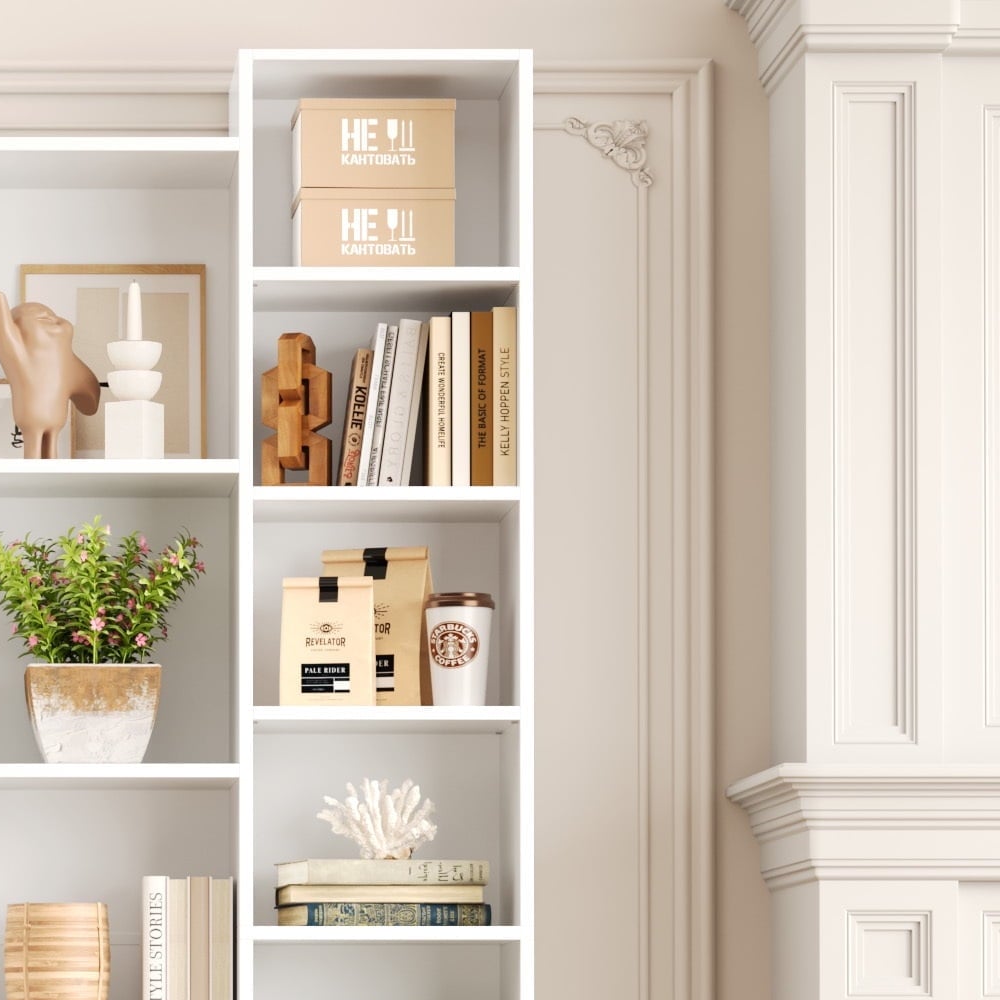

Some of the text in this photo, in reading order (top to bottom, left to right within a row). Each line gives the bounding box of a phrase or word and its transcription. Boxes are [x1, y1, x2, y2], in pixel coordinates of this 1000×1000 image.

[341, 118, 378, 151] НЕ
[341, 154, 416, 166] КАНТОВАТЬ
[341, 208, 378, 241] НЕ
[341, 244, 416, 256] КАНТОВАТЬ
[437, 352, 446, 448] CREATE WONDERFUL HOMELIFE
[478, 349, 487, 449] THE BASIC OF FORMAT
[500, 348, 510, 456] KELLY HOPPEN STYLE
[305, 637, 346, 647] REVELATOR
[431, 623, 477, 643] STARBUCKS
[435, 655, 470, 667] COFFEE
[149, 892, 163, 960] STORIES
